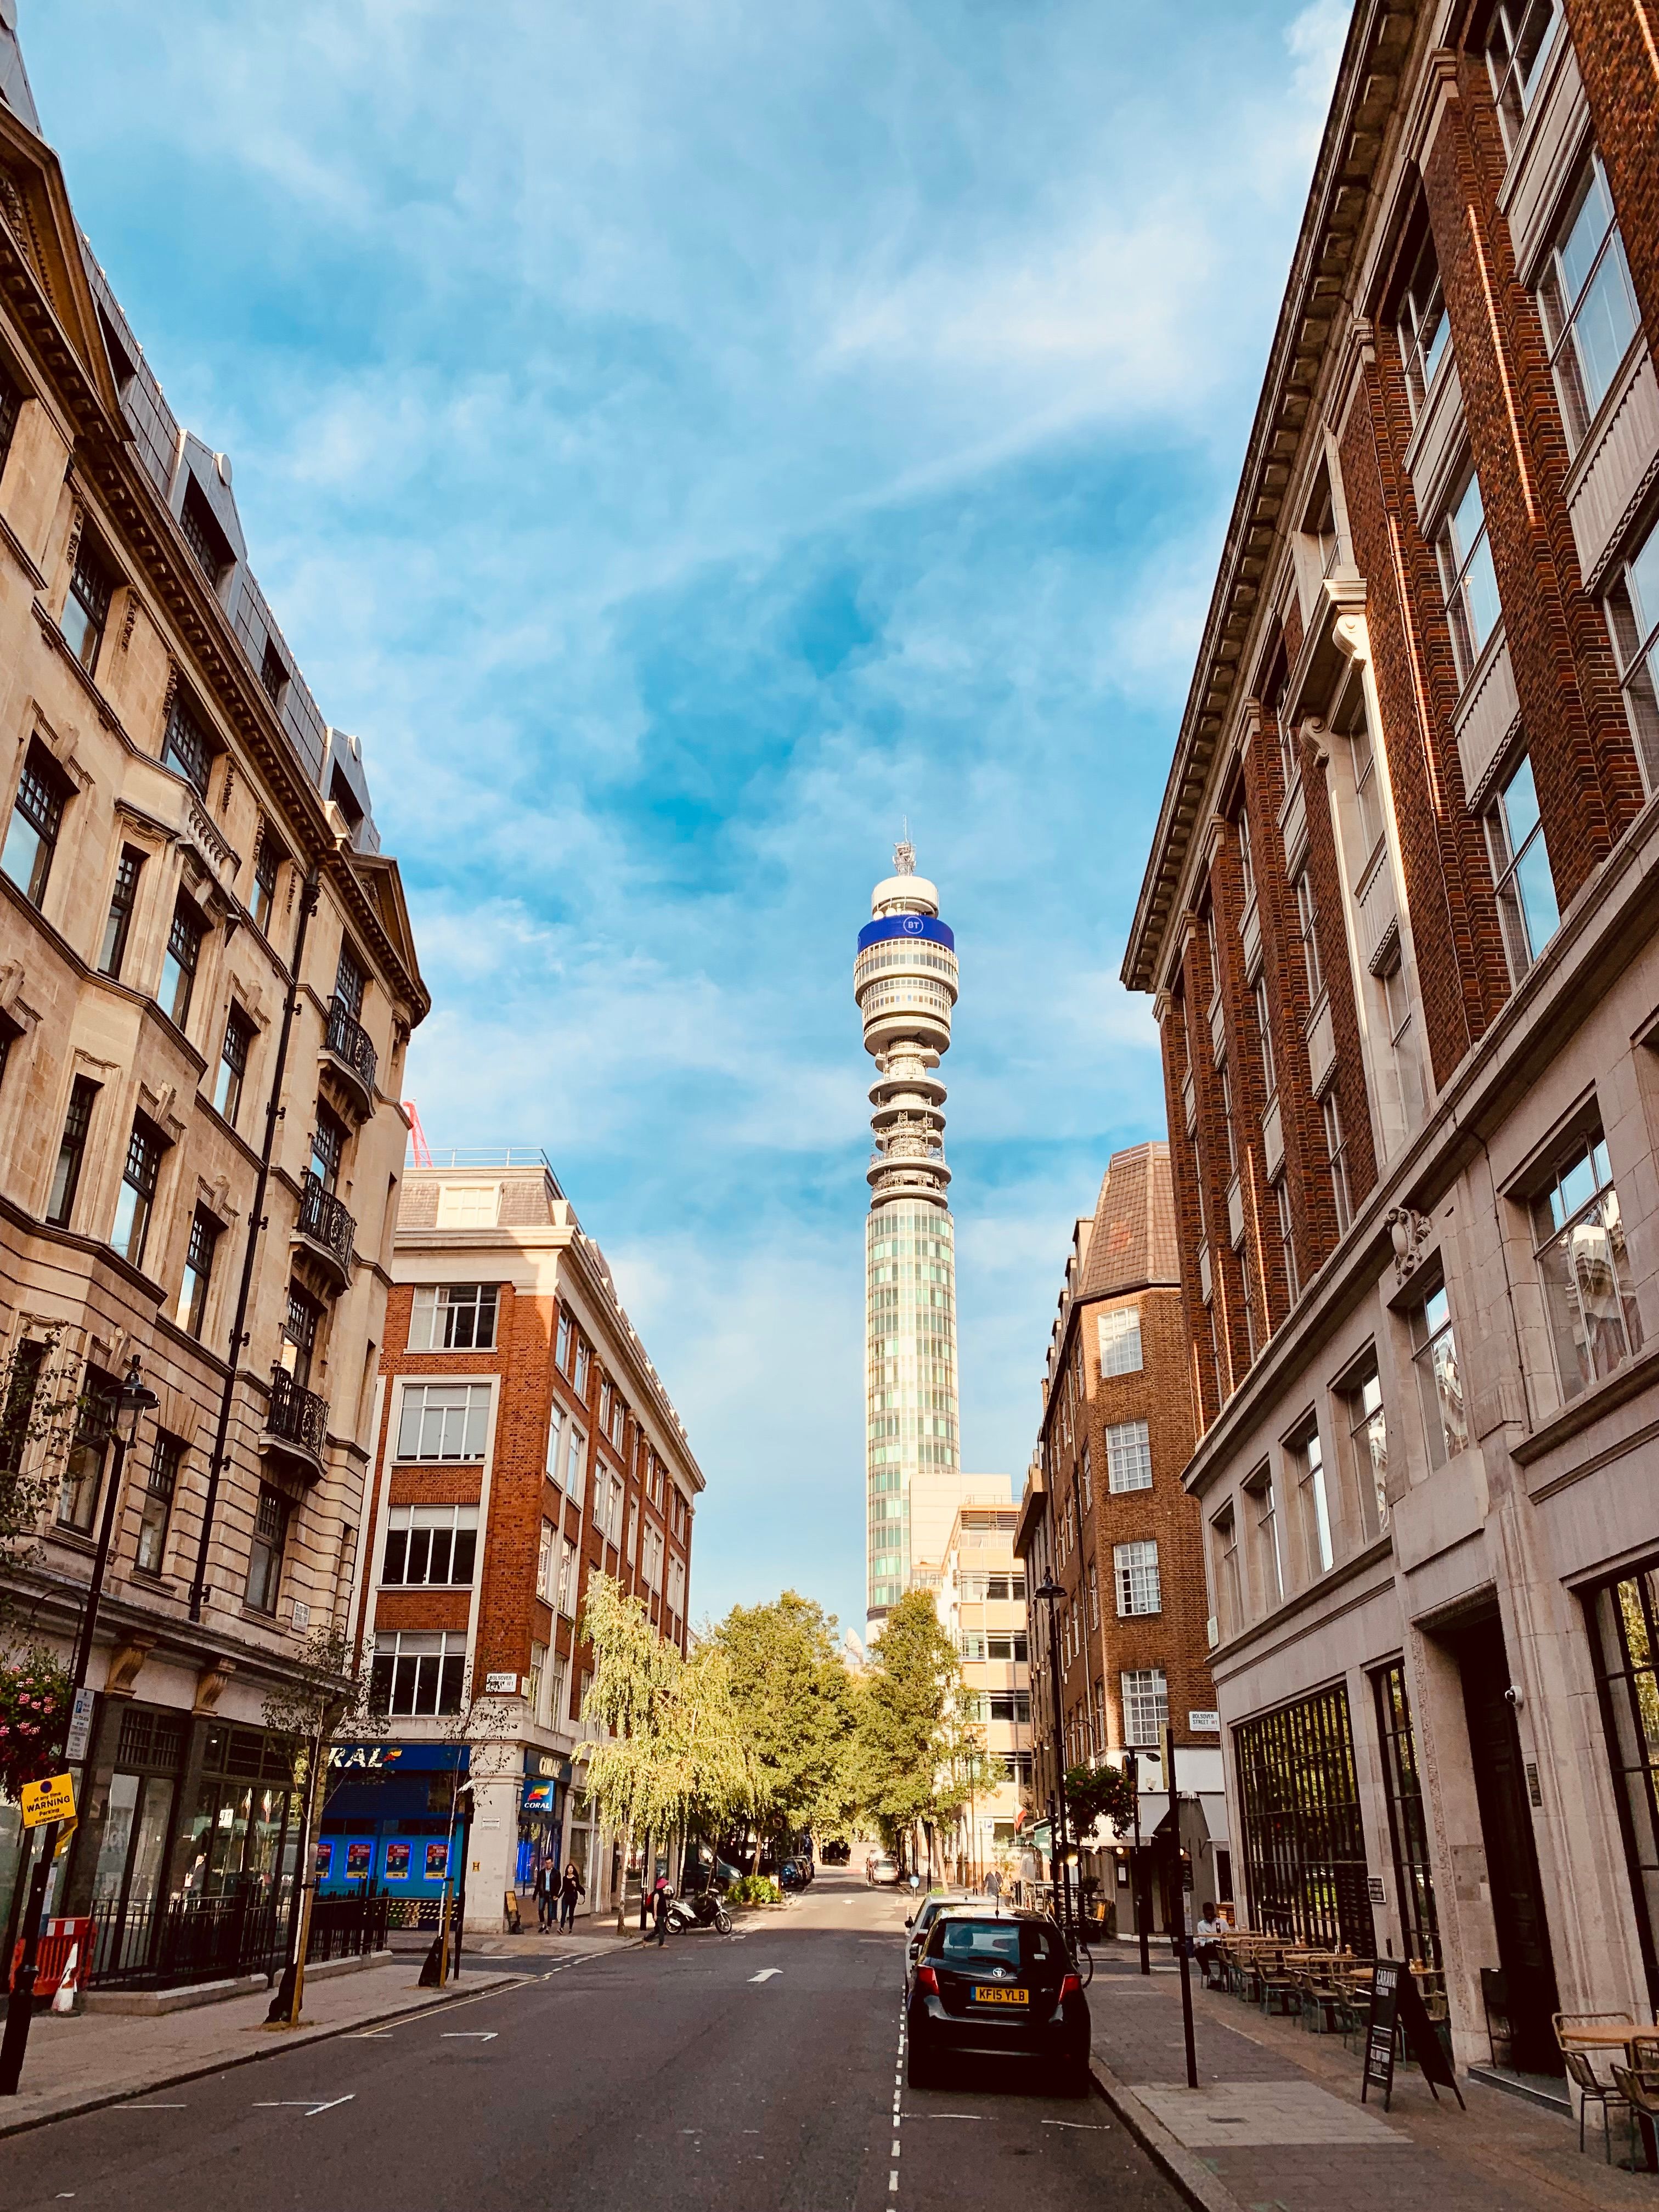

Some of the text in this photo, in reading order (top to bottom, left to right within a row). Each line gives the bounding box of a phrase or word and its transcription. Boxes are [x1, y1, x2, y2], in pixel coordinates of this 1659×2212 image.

[328, 1747, 383, 1767] RAL
[539, 1757, 560, 1778] CORAL
[26, 1795, 70, 1813] WARNING
[35, 1813, 65, 1824] suspension
[39, 1808, 60, 1816] Parking
[472, 1862, 480, 1871] H
[979, 1988, 1025, 2001] KF15 YLB
